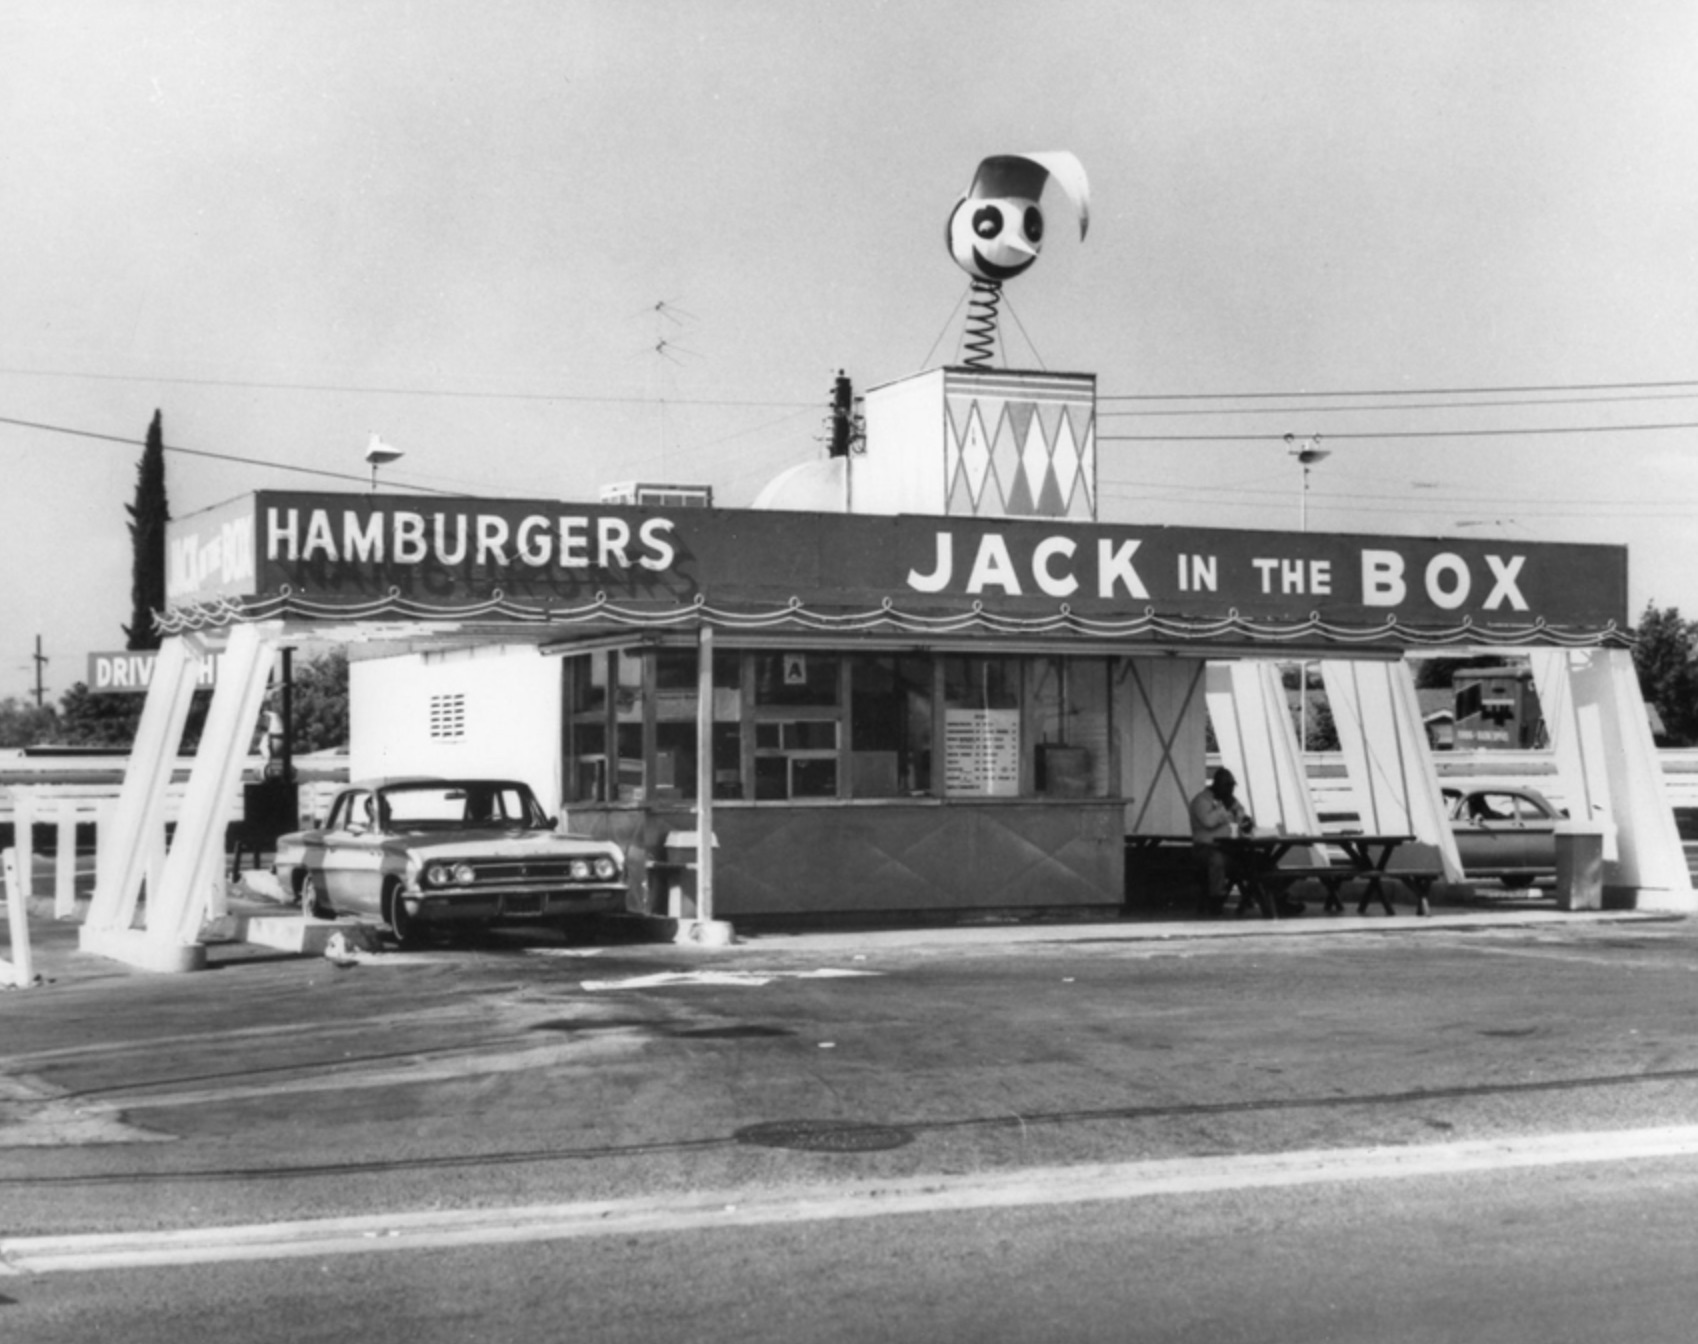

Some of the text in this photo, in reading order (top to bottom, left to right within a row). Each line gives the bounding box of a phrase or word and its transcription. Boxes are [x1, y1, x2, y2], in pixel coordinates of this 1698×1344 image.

[267, 507, 675, 571] HAMBURGERS
[906, 532, 1530, 611] JACK IN THE BOX
[96, 656, 157, 687] DRIV
[788, 662, 802, 678] A
